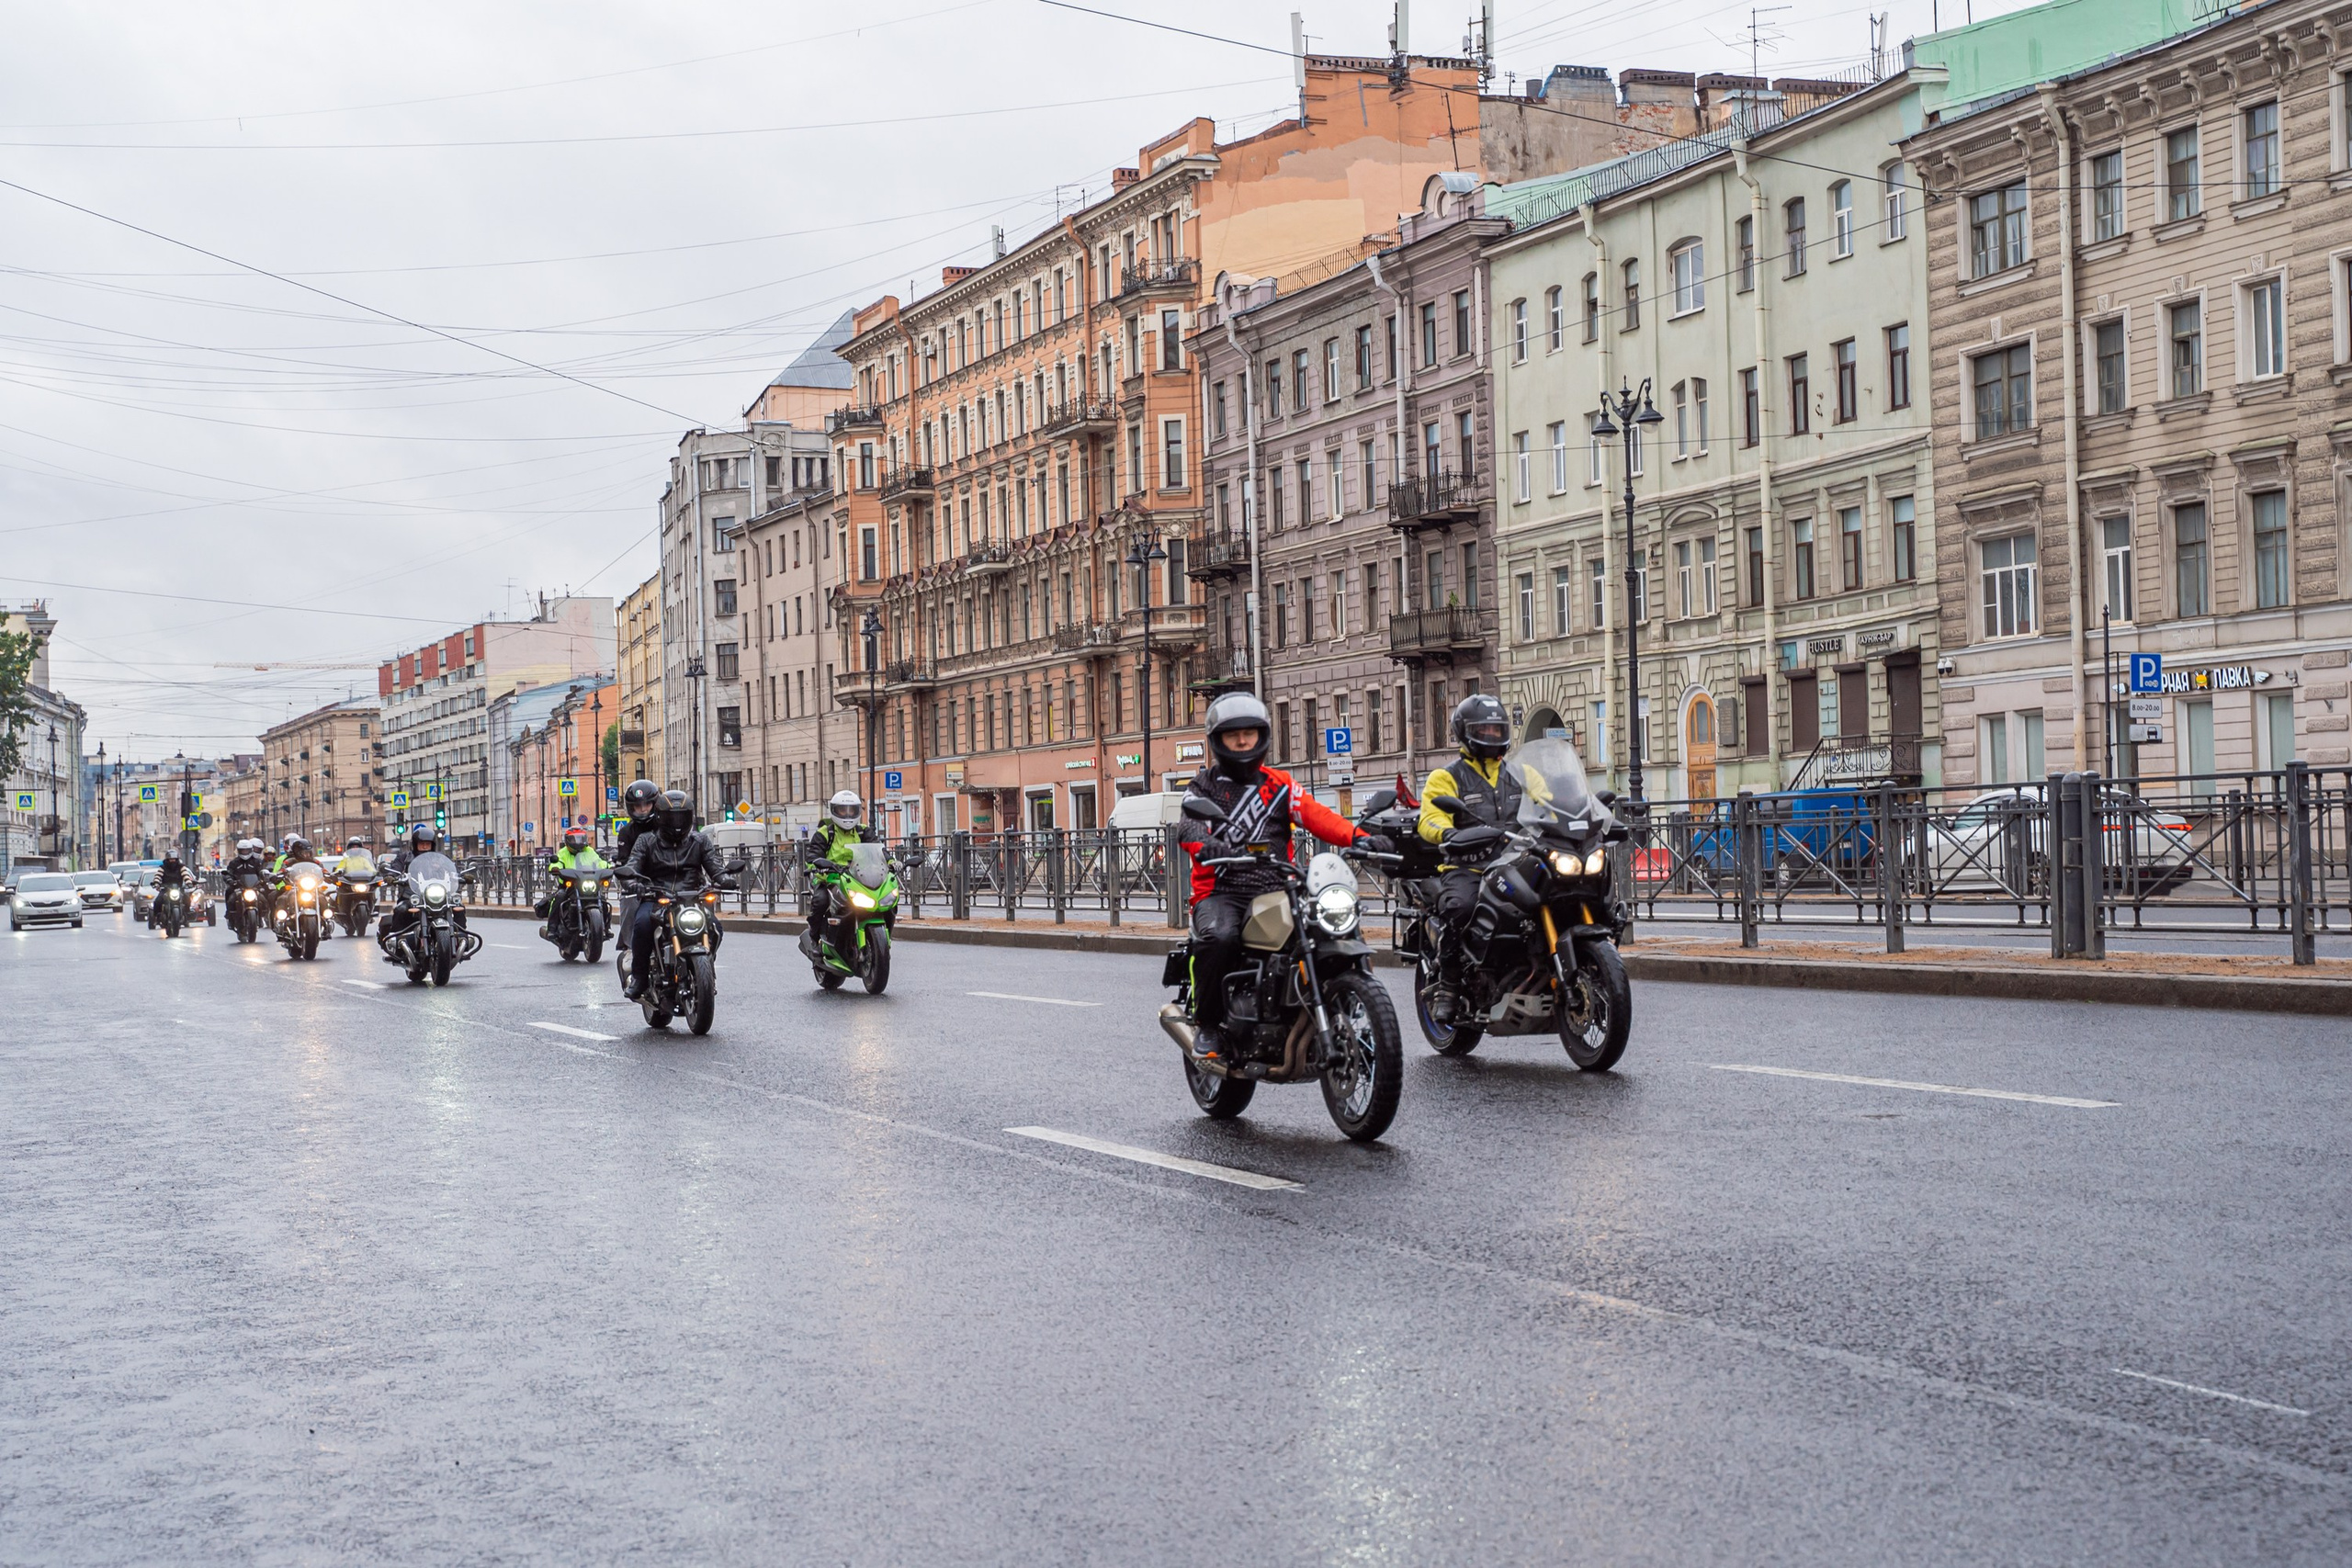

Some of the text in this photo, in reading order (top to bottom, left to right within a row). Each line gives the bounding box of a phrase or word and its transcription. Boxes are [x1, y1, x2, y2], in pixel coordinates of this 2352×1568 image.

[1809, 638, 1841, 654] HUSTLE
[2139, 657, 2156, 688] P
[2213, 666, 2251, 689] ЛАВКА
[2132, 704, 2160, 712] 8.00-20.00
[1332, 730, 1347, 750] P
[889, 773, 899, 787] P
